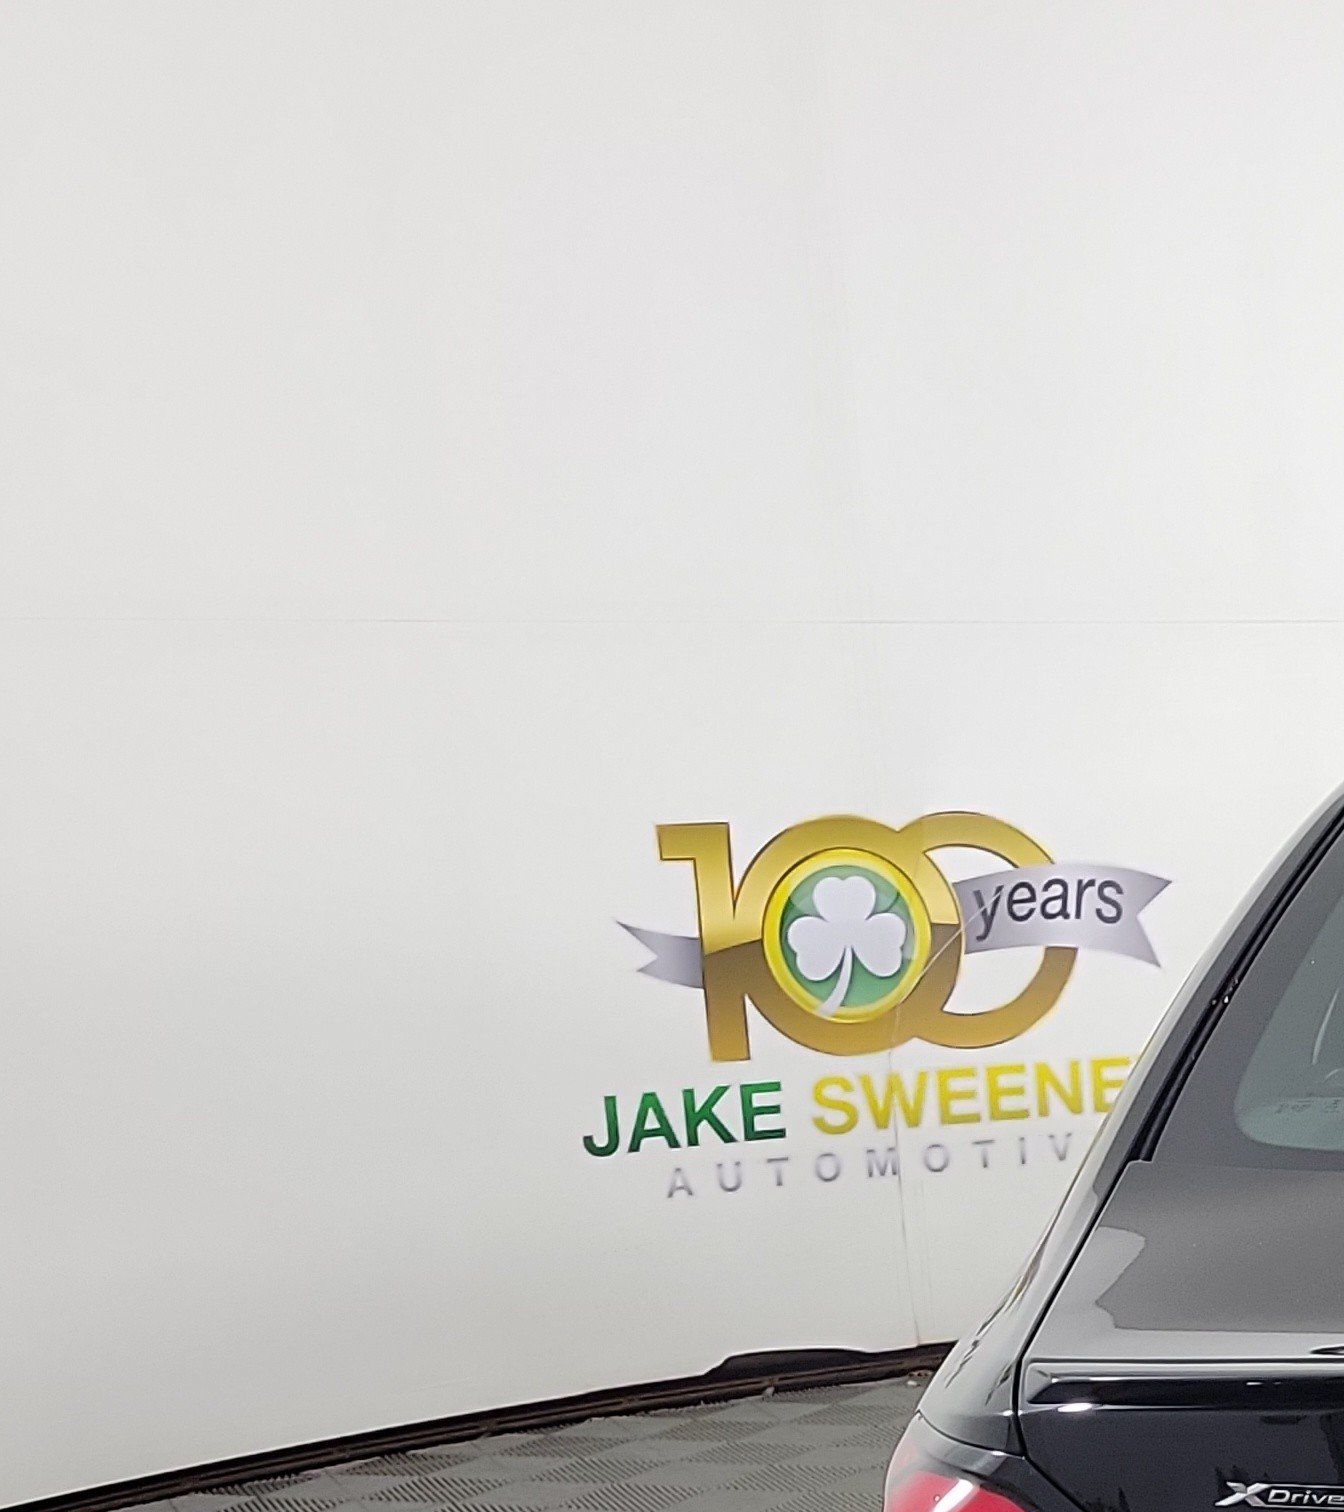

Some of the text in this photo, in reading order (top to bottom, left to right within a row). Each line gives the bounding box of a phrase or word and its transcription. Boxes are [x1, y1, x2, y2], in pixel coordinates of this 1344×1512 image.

[655, 811, 1079, 1063] 100
[972, 875, 1124, 941] years
[583, 1056, 1130, 1157] JAKE SWEENE
[667, 1132, 1073, 1199] AUTOMOTIV
